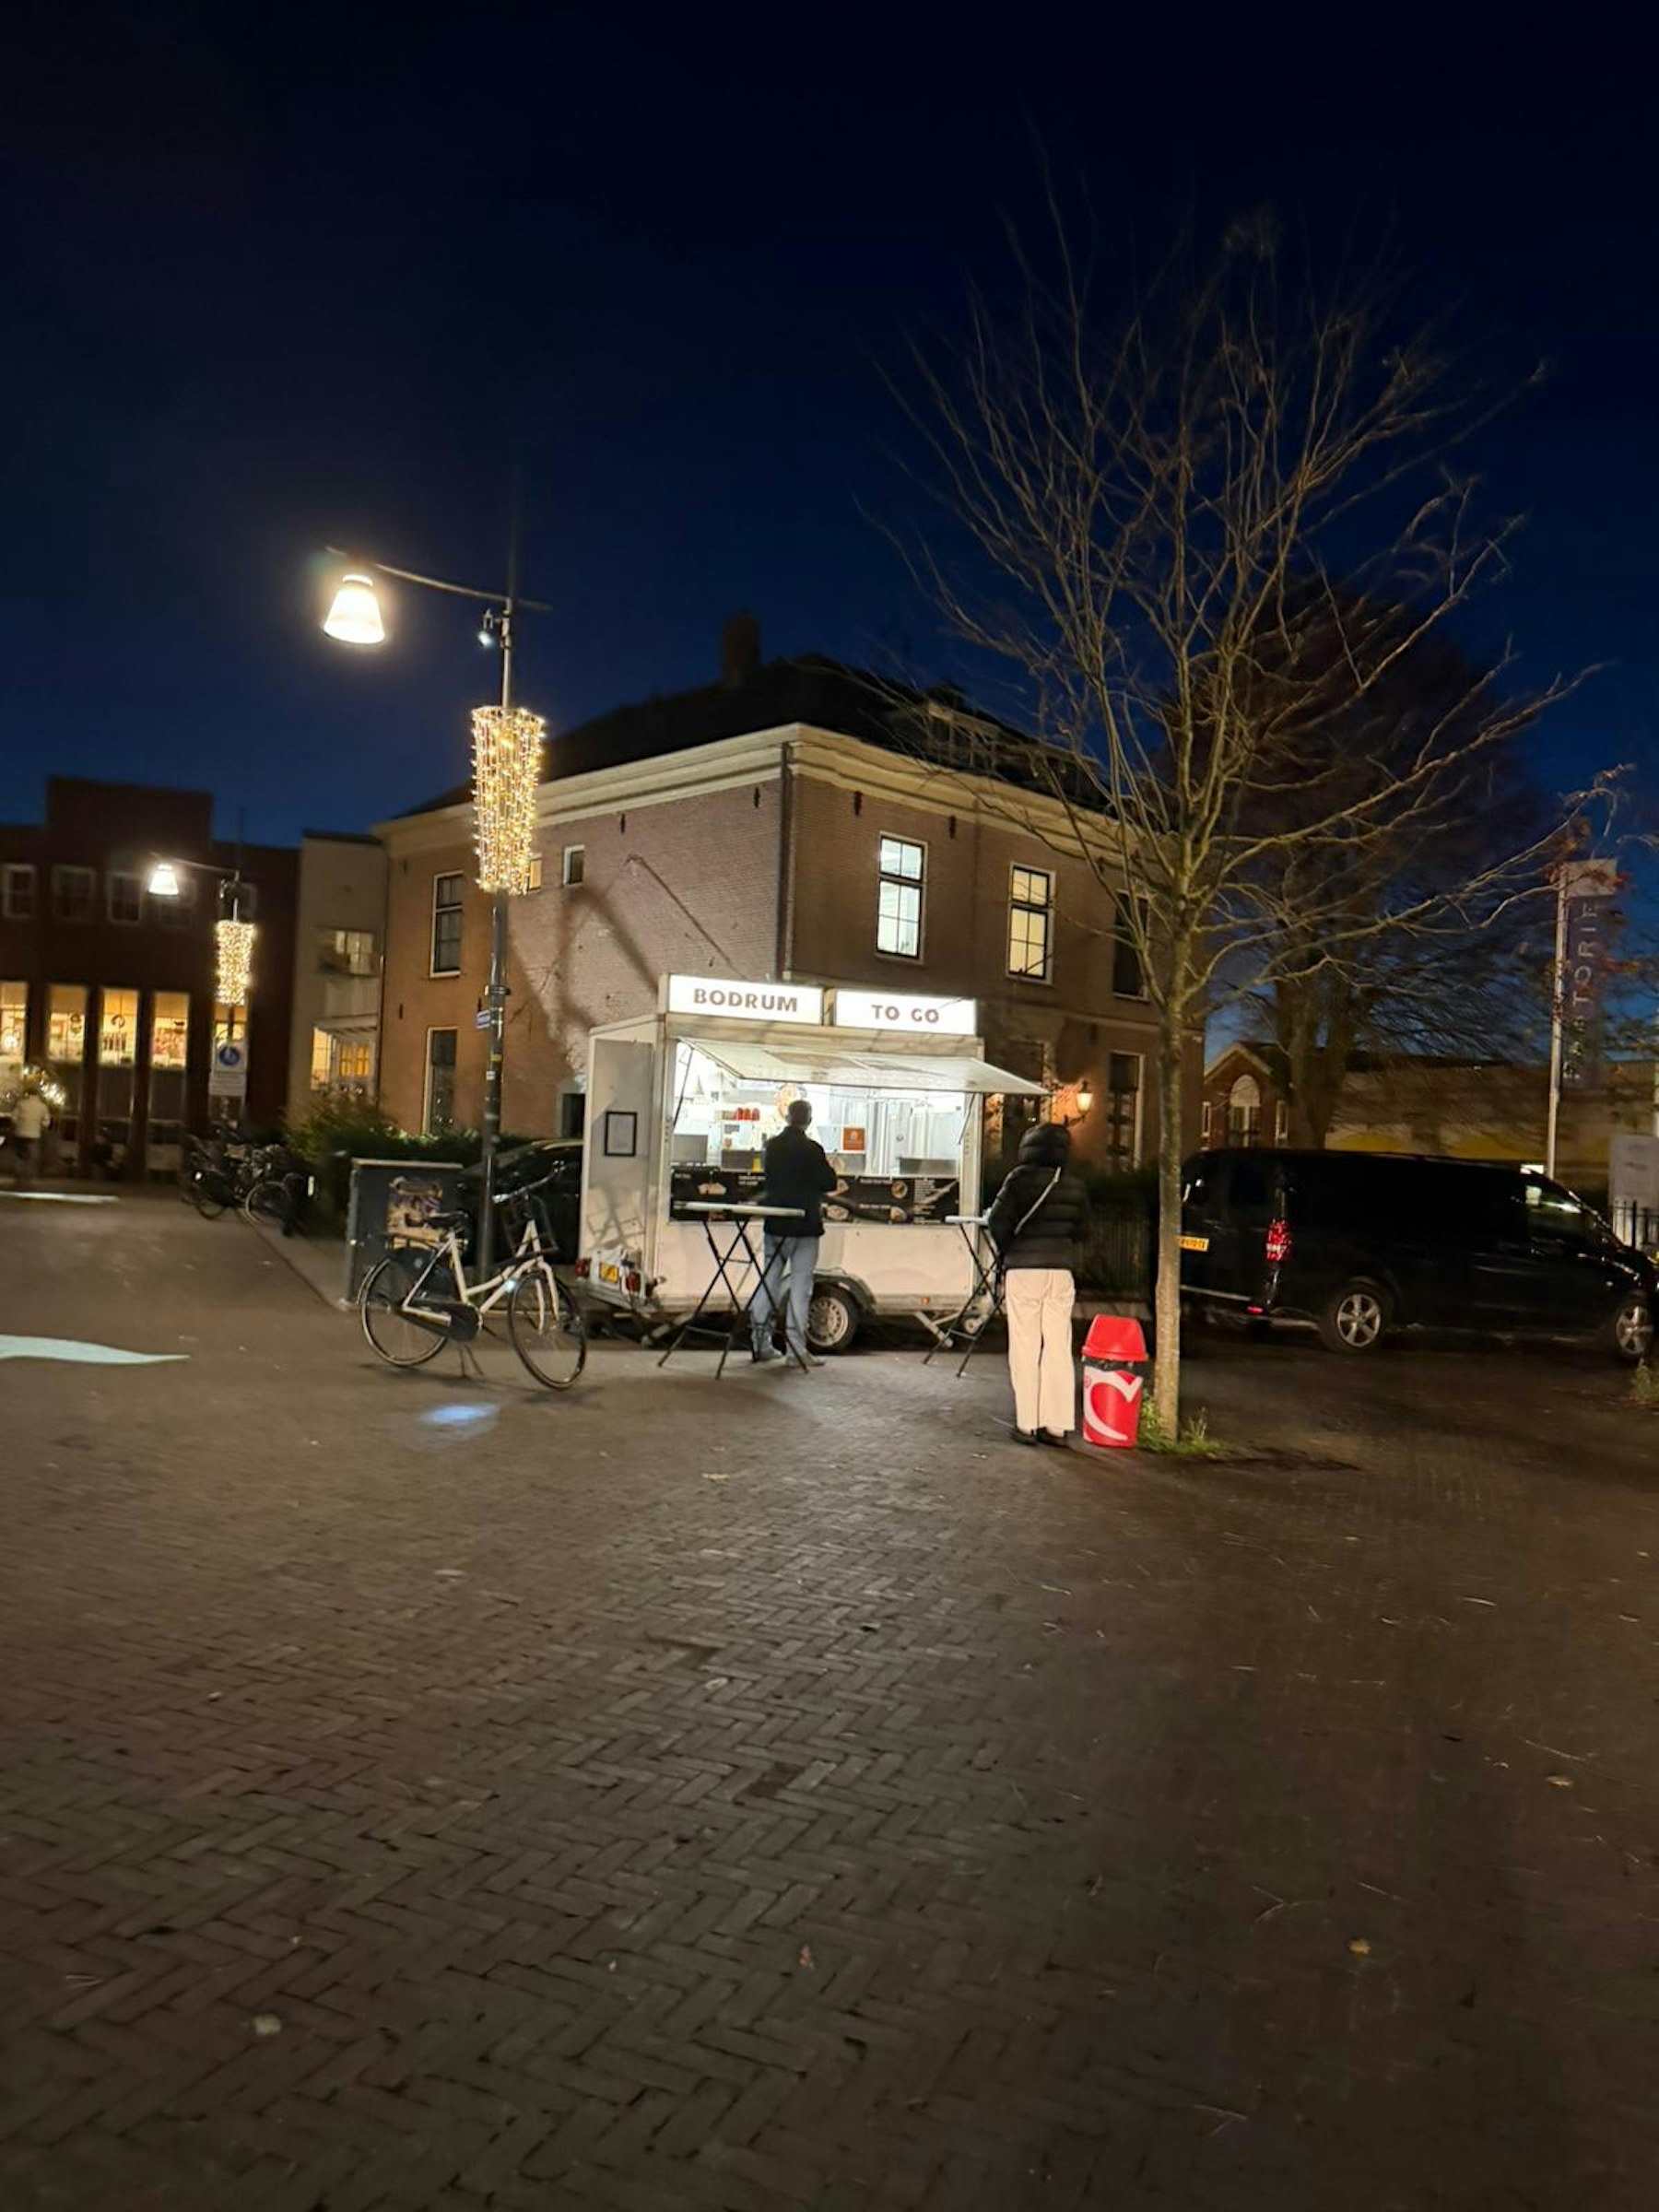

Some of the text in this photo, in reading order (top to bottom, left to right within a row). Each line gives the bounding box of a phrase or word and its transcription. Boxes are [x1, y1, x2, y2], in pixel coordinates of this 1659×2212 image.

[693, 988, 797, 1012] BODRUM
[871, 1005, 940, 1024] TO GO
